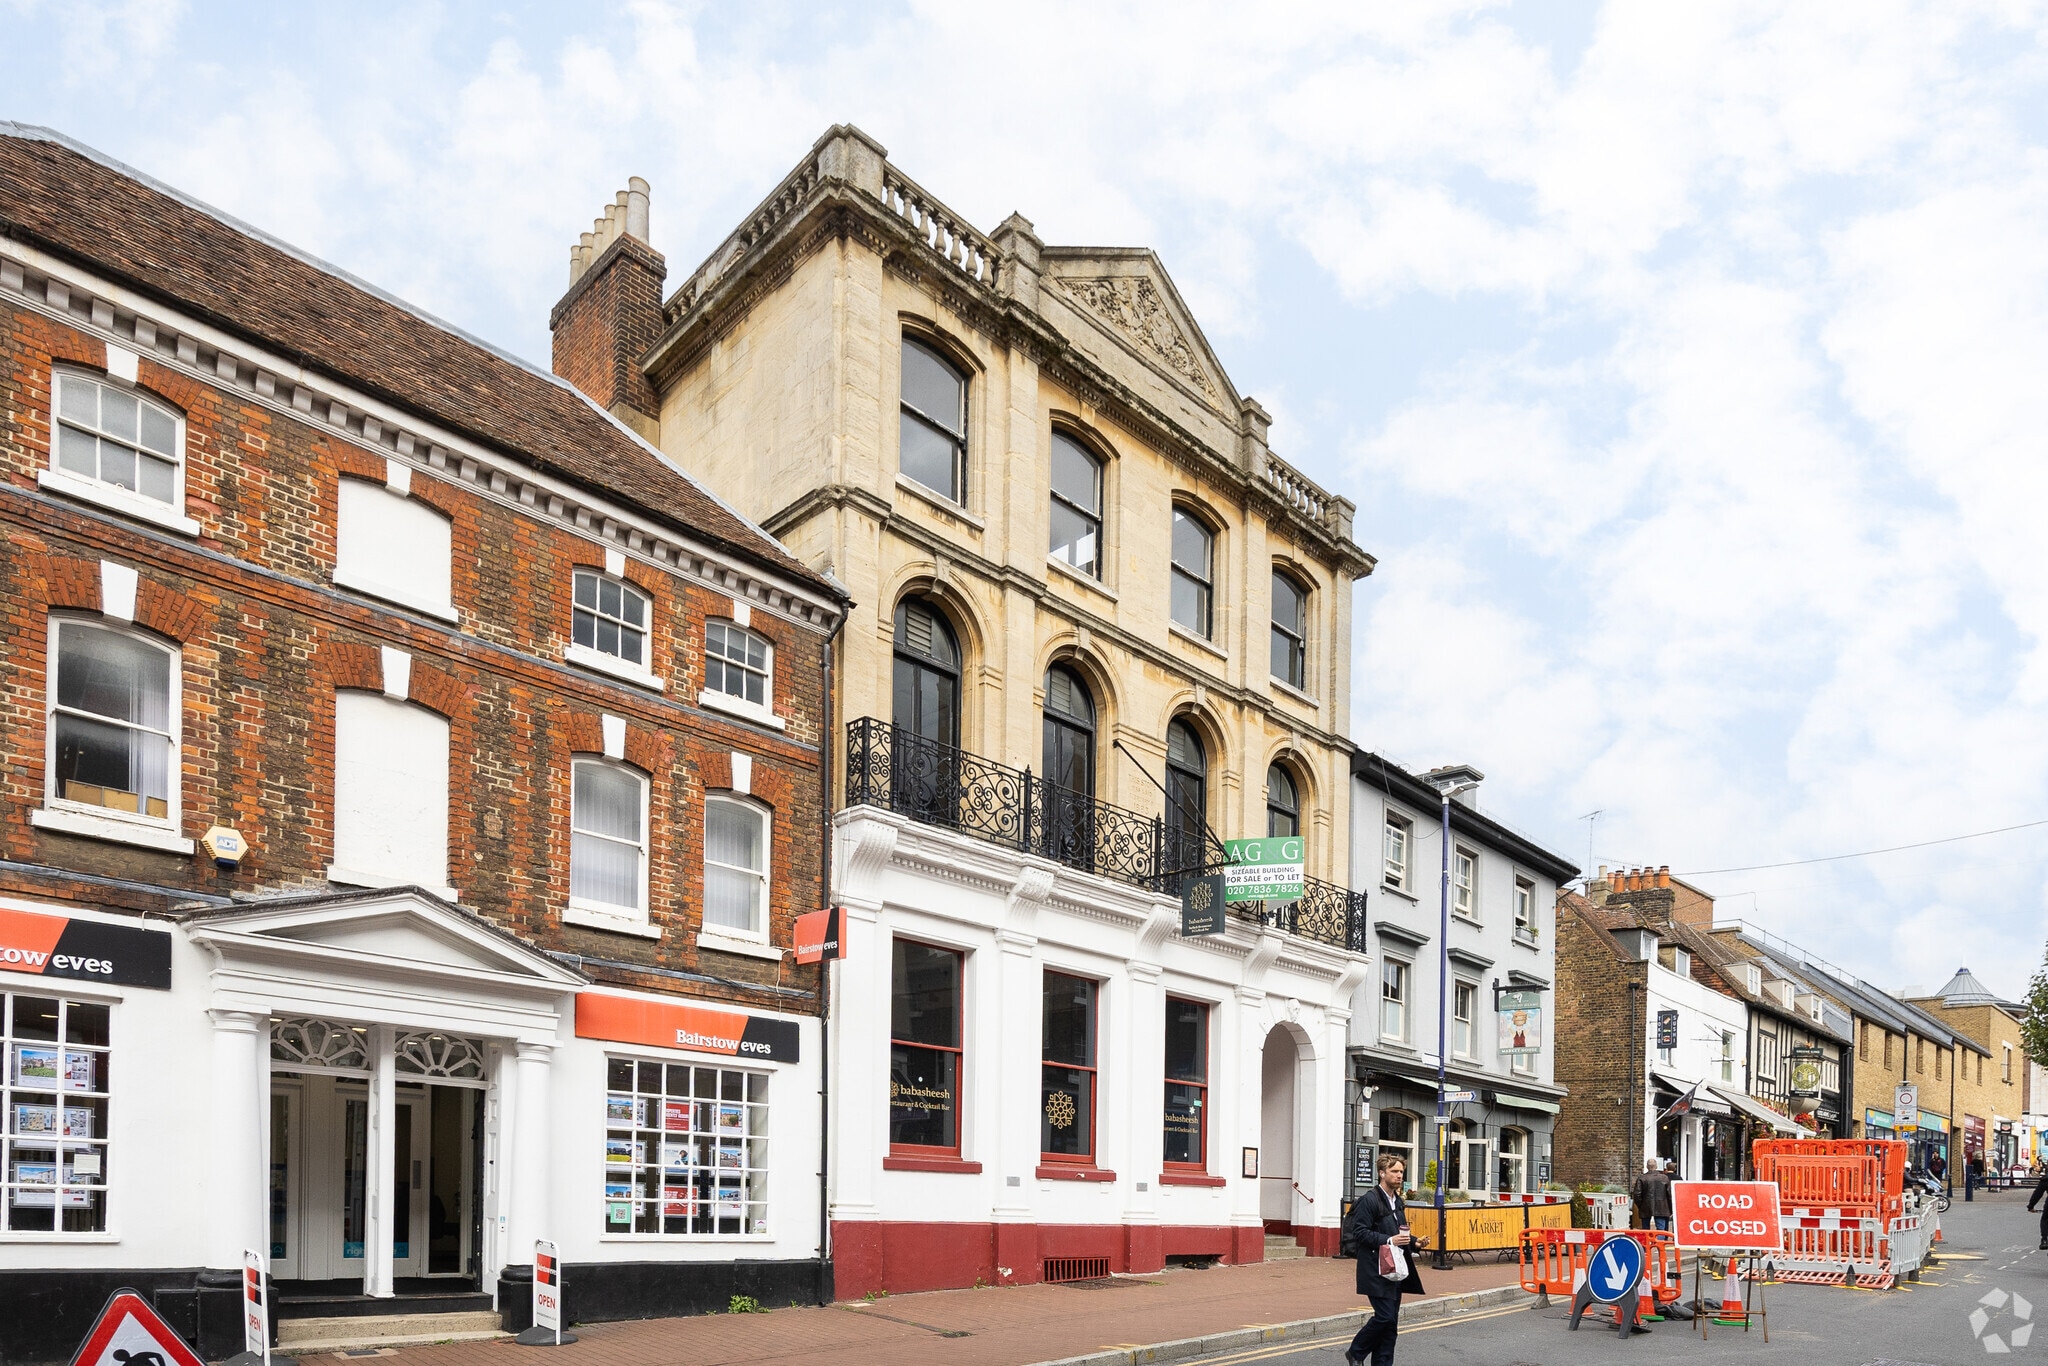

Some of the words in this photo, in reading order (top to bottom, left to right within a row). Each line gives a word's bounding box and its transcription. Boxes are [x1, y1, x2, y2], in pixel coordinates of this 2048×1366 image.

[217, 838, 238, 850] ADT
[1231, 868, 1260, 876] SIZEABLE
[1262, 866, 1295, 874] BUILDING
[1287, 873, 1300, 881] LET
[1227, 886, 1245, 895] 020
[1248, 885, 1272, 894] 7836
[1275, 884, 1299, 893] 7826
[798, 943, 823, 955] Bairstow
[823, 940, 838, 950] eves
[52, 954, 113, 974] eves
[676, 1029, 740, 1050] Bairstow
[741, 1041, 771, 1055] eves
[900, 1084, 950, 1099] babasheesh
[1165, 1112, 1198, 1124] babasheesh
[1698, 1194, 1753, 1209] ROAD
[1468, 1218, 1504, 1234] MARKET
[1689, 1219, 1767, 1235] CLOSED
[538, 1293, 556, 1310] OPEN
[248, 1313, 261, 1332] OPEN
